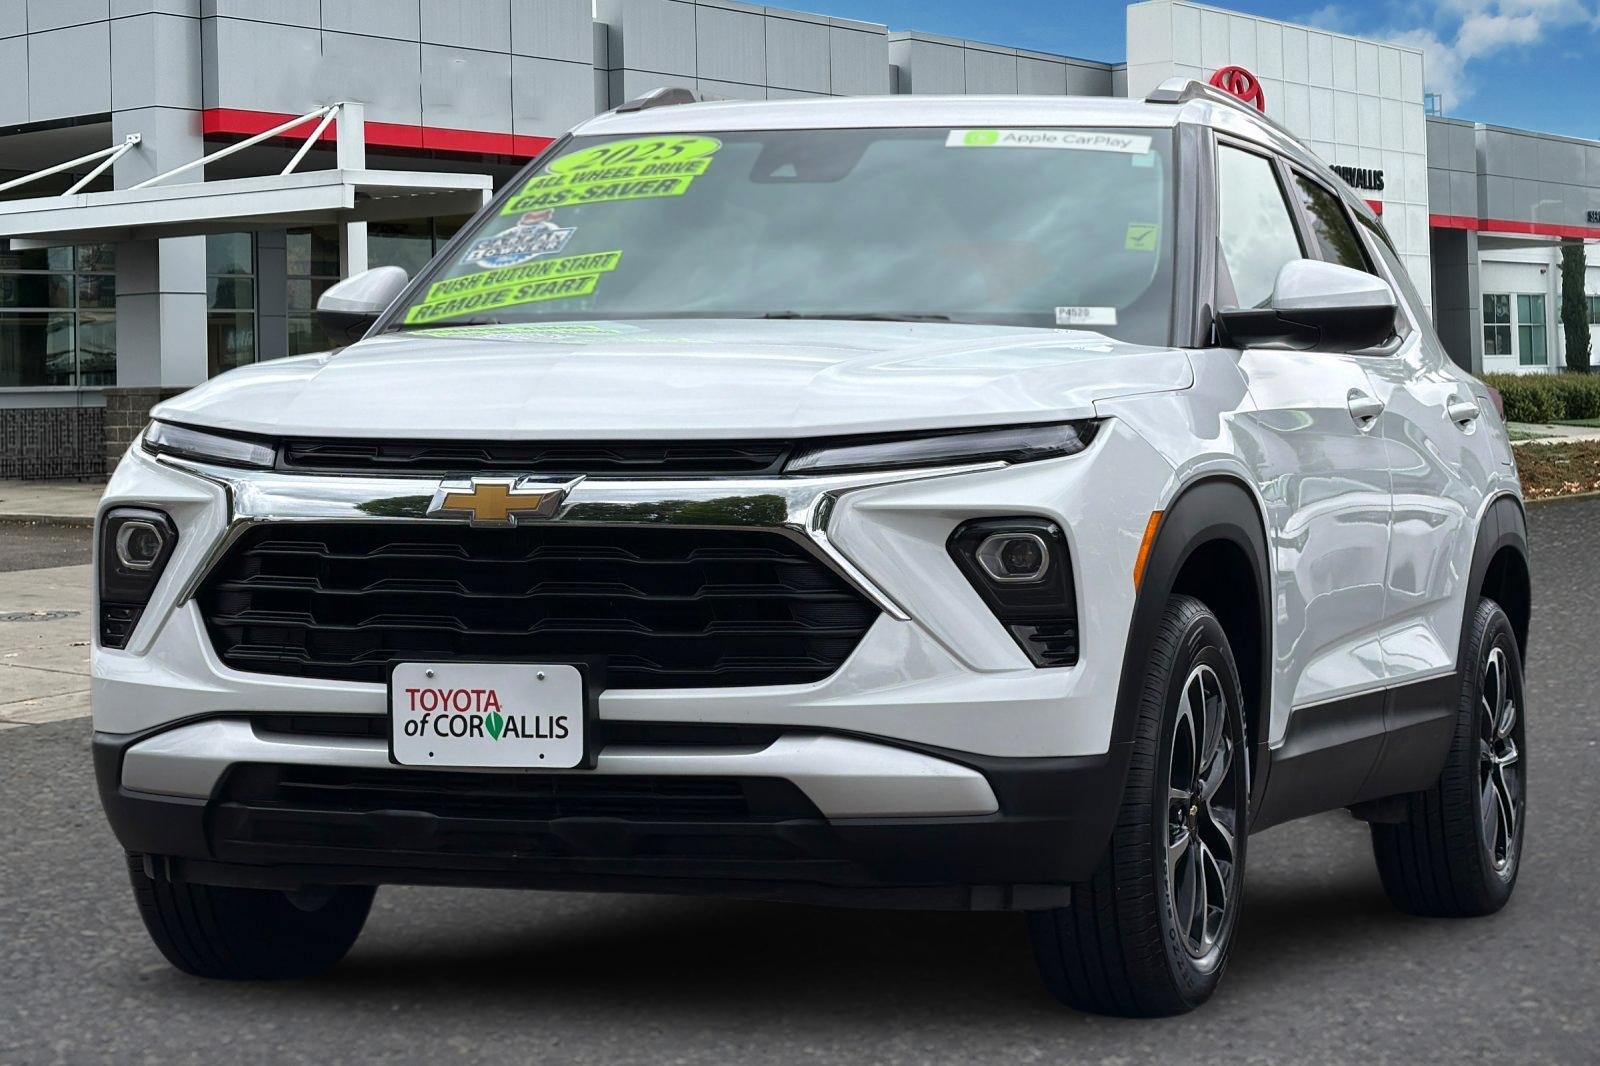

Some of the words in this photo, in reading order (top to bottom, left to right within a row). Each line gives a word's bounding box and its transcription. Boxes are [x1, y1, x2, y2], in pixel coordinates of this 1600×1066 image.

[568, 139, 699, 171] 2025
[1003, 132, 1058, 145] Apple
[1062, 133, 1133, 149] CarPlay
[527, 175, 565, 191] ALL
[570, 164, 636, 184] WHEEL
[638, 159, 707, 177] DRIVE
[1328, 164, 1385, 191] RVALLIS
[431, 274, 485, 299] PUSH
[481, 261, 556, 286] BUTTON
[555, 253, 615, 273] START
[411, 288, 509, 322] REMOTE
[512, 275, 593, 300] START
[405, 688, 501, 713] TOYOTA
[404, 712, 431, 737] of
